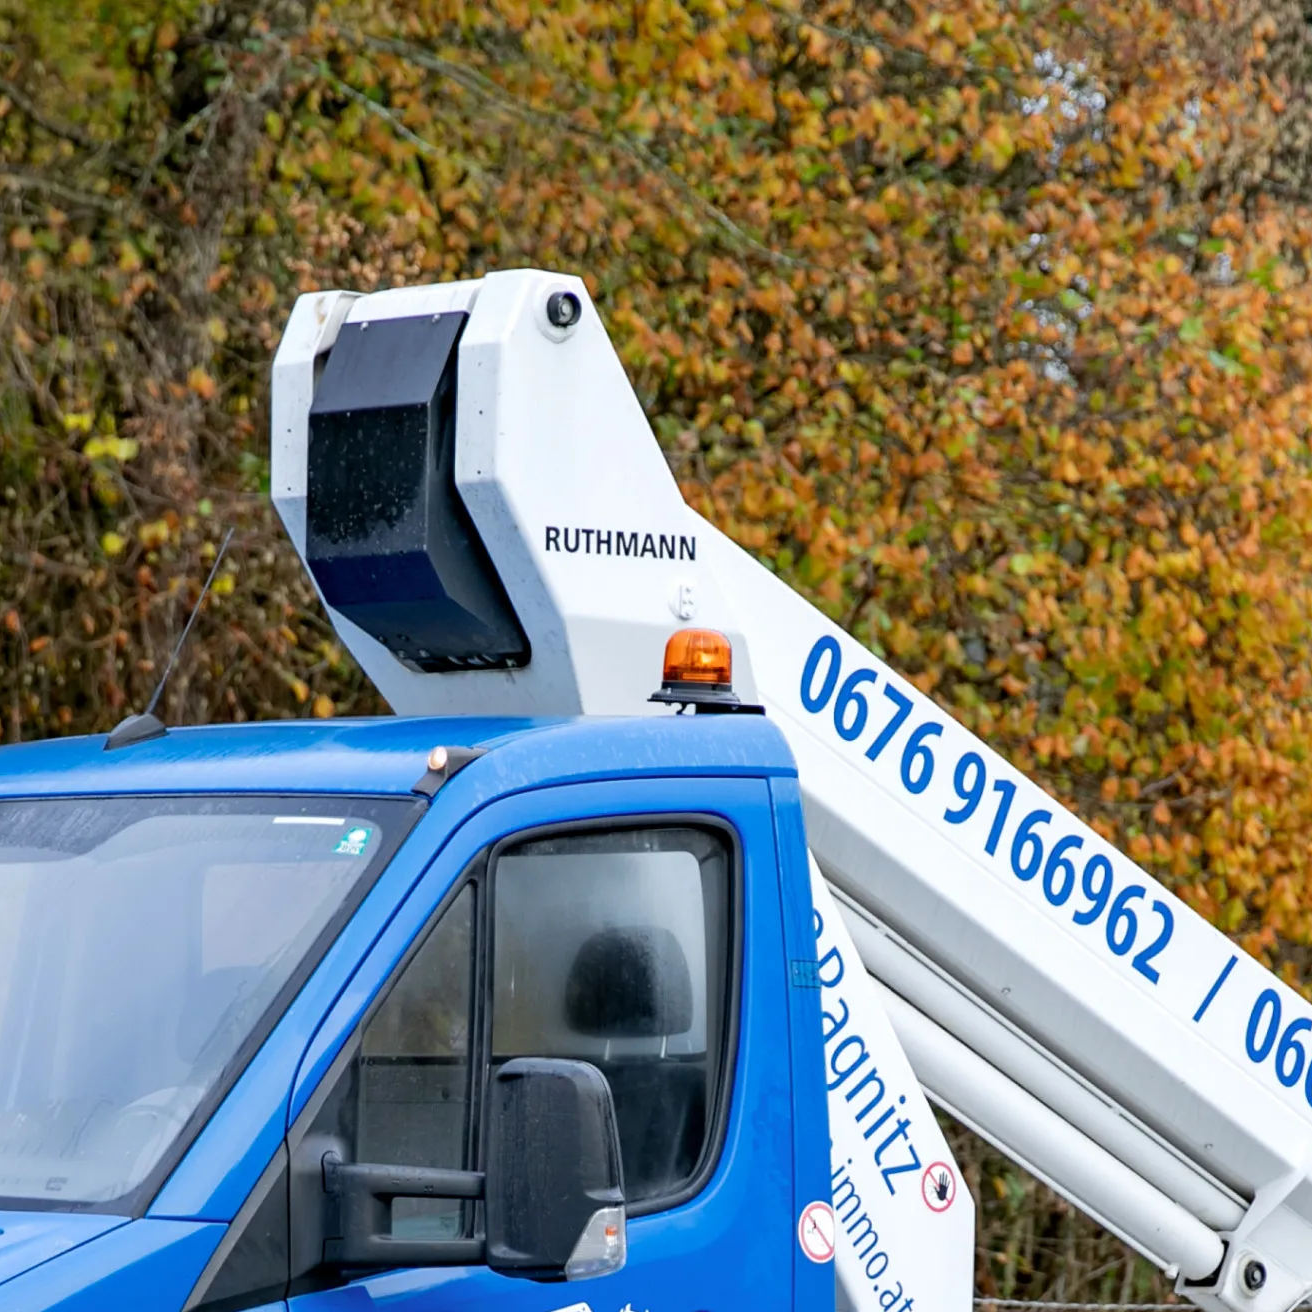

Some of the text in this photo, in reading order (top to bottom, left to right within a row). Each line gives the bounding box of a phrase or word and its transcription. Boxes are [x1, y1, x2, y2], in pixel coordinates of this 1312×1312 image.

[545, 526, 696, 561] RUTHMANN
[800, 635, 944, 795] 0676
[943, 751, 1174, 985] 9166962
